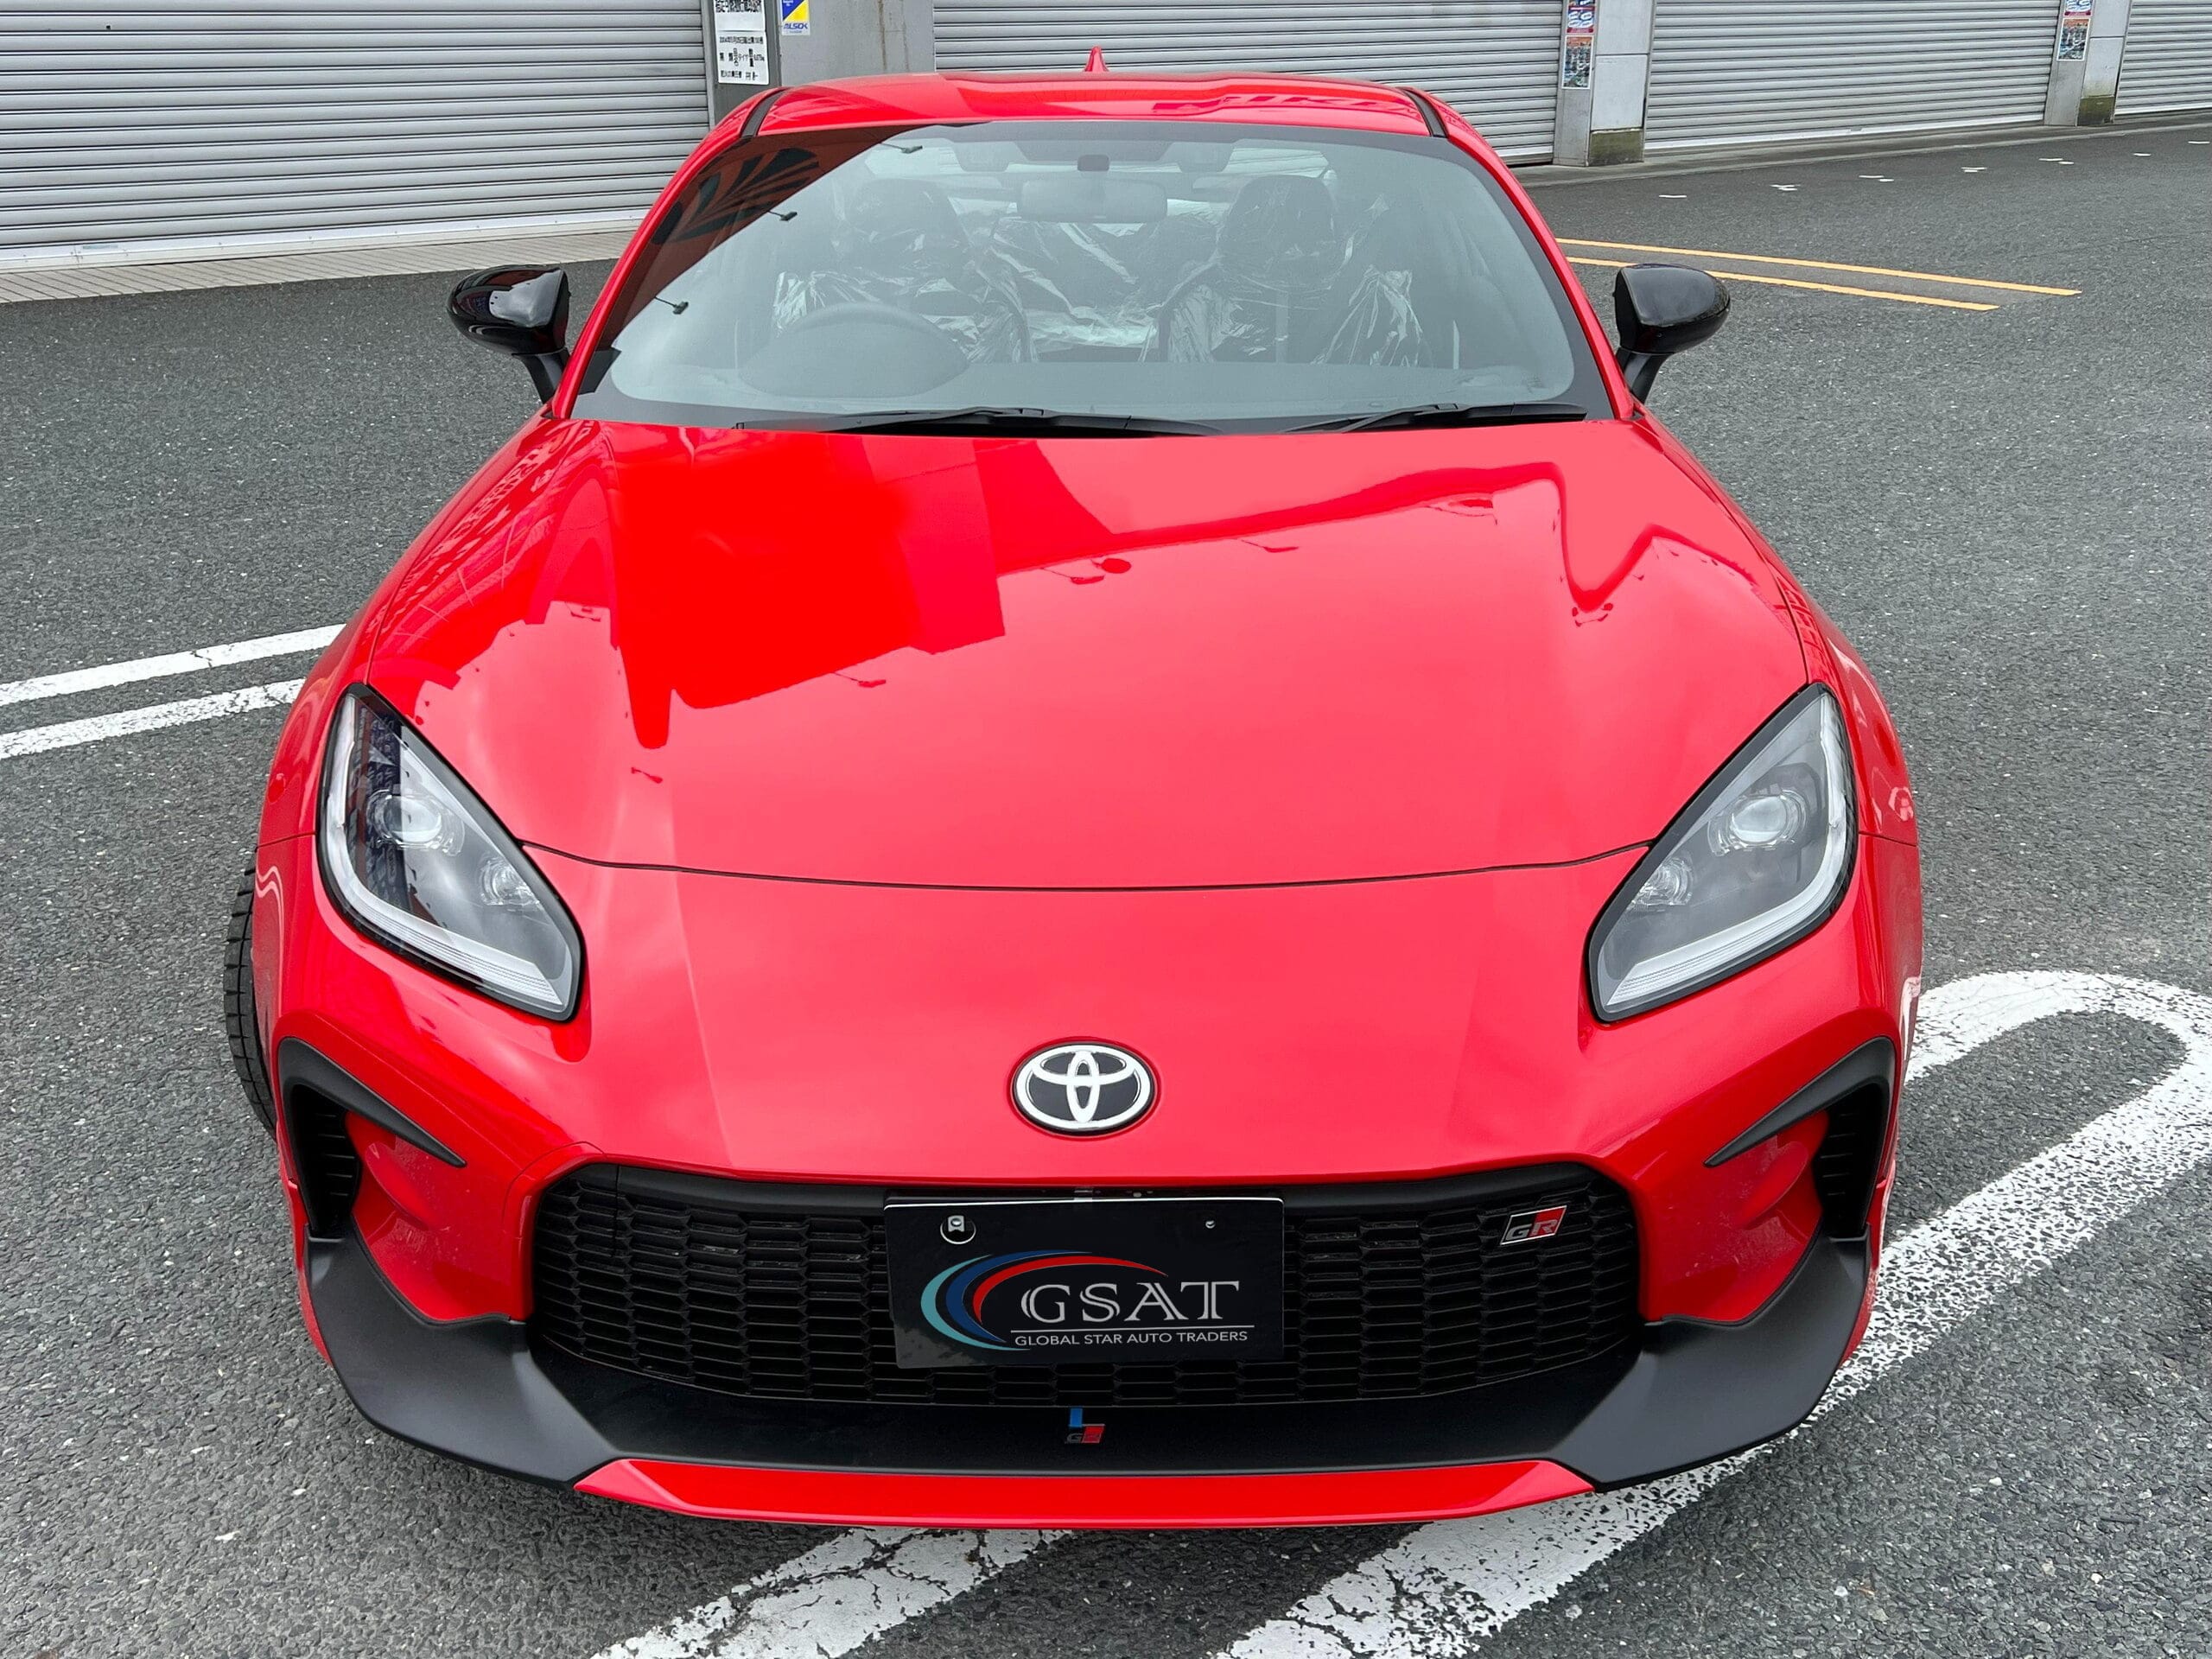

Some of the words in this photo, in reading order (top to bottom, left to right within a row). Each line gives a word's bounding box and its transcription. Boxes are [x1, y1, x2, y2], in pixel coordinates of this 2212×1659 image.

[1505, 1218, 1558, 1241] GR
[1020, 1281, 1239, 1323] GSAT
[1014, 1335, 1080, 1346] GLOBAL
[1084, 1333, 1122, 1344] STAR
[1127, 1332, 1173, 1344] AUTO
[1176, 1331, 1248, 1342] TRADERS
